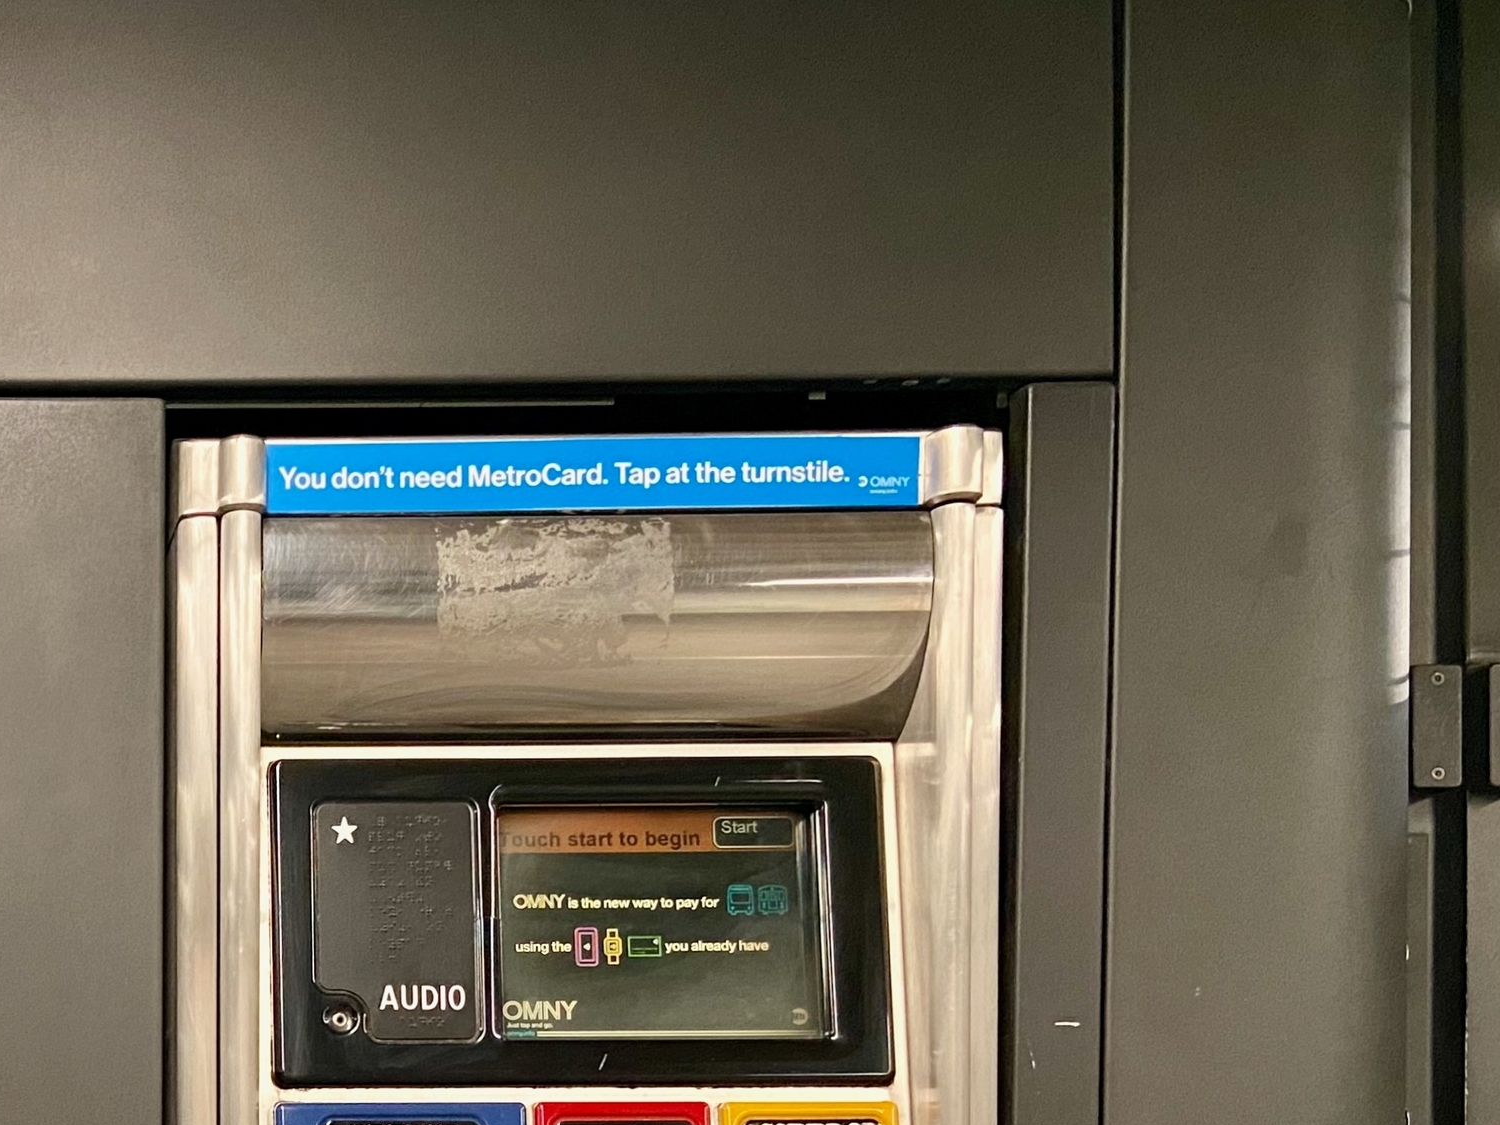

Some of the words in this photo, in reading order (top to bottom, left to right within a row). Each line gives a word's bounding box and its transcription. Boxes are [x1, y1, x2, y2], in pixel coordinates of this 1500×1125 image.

[278, 466, 326, 491] You
[331, 466, 394, 490] don't
[400, 465, 462, 489] need
[467, 463, 608, 488] MetroCard.
[614, 461, 660, 488] Tap
[666, 463, 690, 485] at
[695, 461, 736, 484] the
[740, 460, 850, 483] turnstile.
[870, 475, 910, 487] OMNY
[721, 820, 758, 834] Start
[500, 832, 560, 847] Touch
[568, 832, 613, 846] start
[619, 832, 638, 846] to
[645, 831, 700, 850] begin
[513, 894, 565, 909] OMNY
[568, 897, 579, 909] is
[580, 897, 601, 909] the
[604, 899, 630, 909] new
[632, 899, 658, 911] way
[660, 897, 674, 908] to
[675, 899, 700, 911] pay
[701, 896, 720, 908] for
[516, 942, 549, 954] using
[552, 941, 572, 952] the
[665, 942, 689, 954] you
[691, 940, 737, 954] already
[738, 941, 769, 951] have
[380, 984, 466, 1011] AUDIO
[503, 1000, 577, 1020] OMNY
